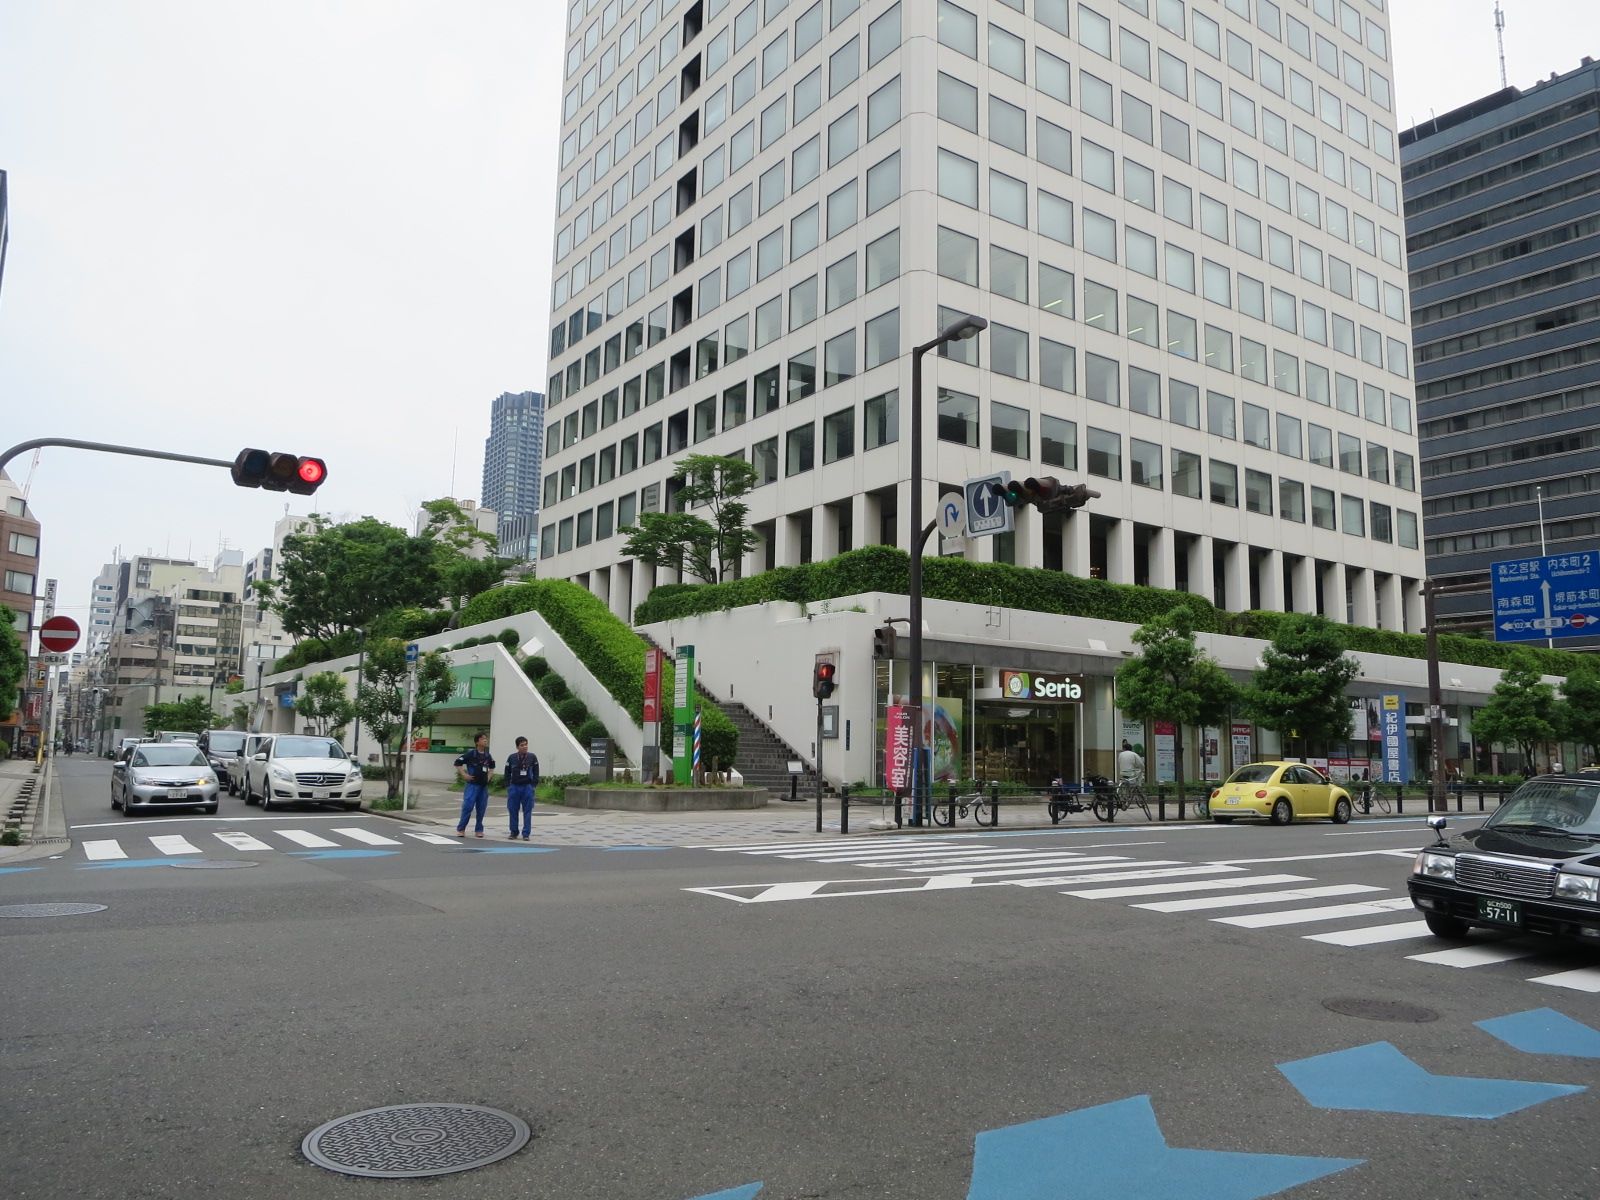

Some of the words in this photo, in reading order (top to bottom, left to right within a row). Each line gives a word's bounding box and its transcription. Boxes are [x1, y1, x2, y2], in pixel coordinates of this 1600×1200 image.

[1498, 561, 1540, 575] 森之宮駅
[1497, 595, 1534, 608] 南森町
[1555, 588, 1600, 603] 堺筋本町
[1034, 677, 1081, 698] Seria
[891, 724, 909, 787] 美容室
[1487, 907, 1517, 922] 57-11
